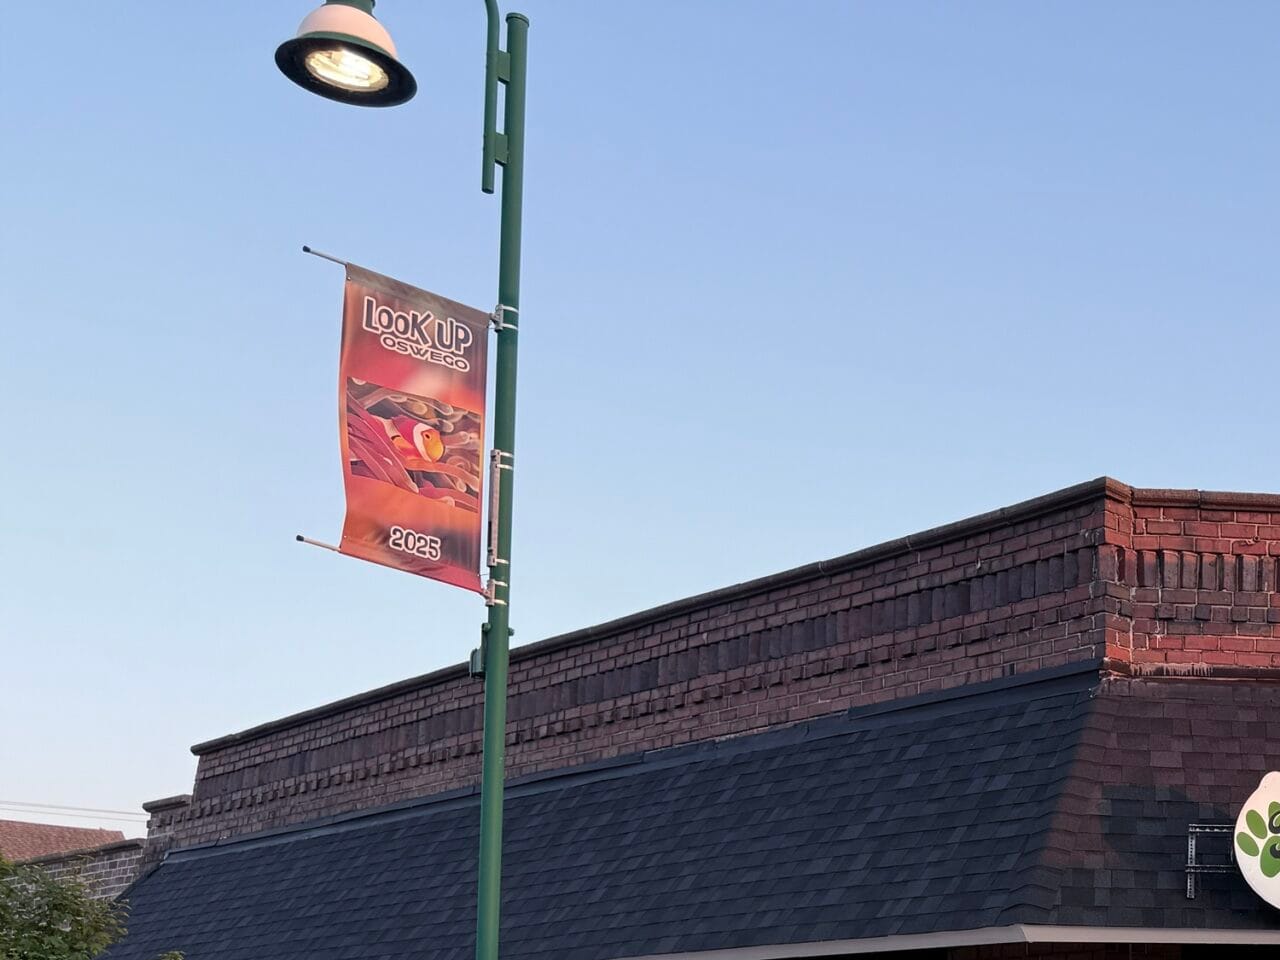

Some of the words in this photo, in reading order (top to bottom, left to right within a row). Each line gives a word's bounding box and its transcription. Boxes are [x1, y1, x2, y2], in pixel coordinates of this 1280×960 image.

[380, 333, 470, 373] OSWEGO
[435, 317, 473, 355] UP
[389, 526, 441, 561] 2025
